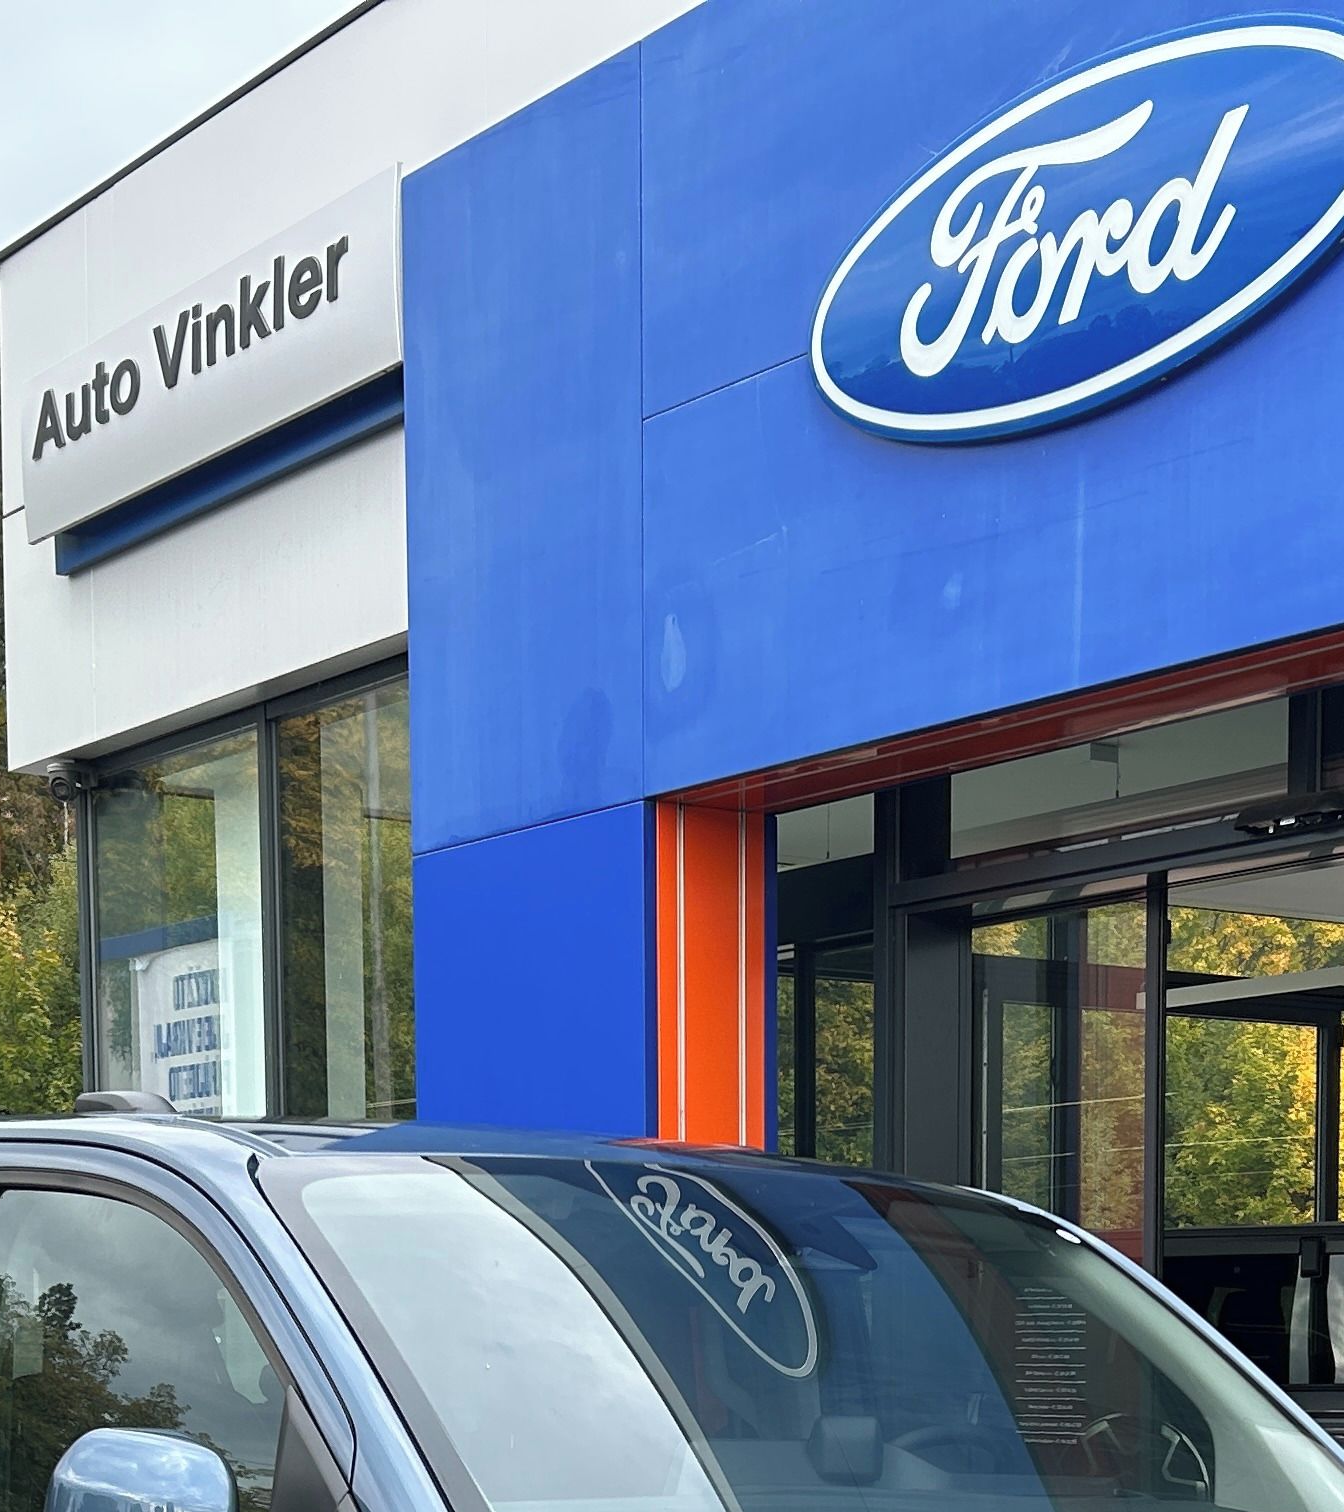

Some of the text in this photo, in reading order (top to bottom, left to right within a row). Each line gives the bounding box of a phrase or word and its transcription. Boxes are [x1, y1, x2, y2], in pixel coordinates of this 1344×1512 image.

[32, 234, 349, 461] Auto Vinkler
[899, 99, 1250, 378] Ford
